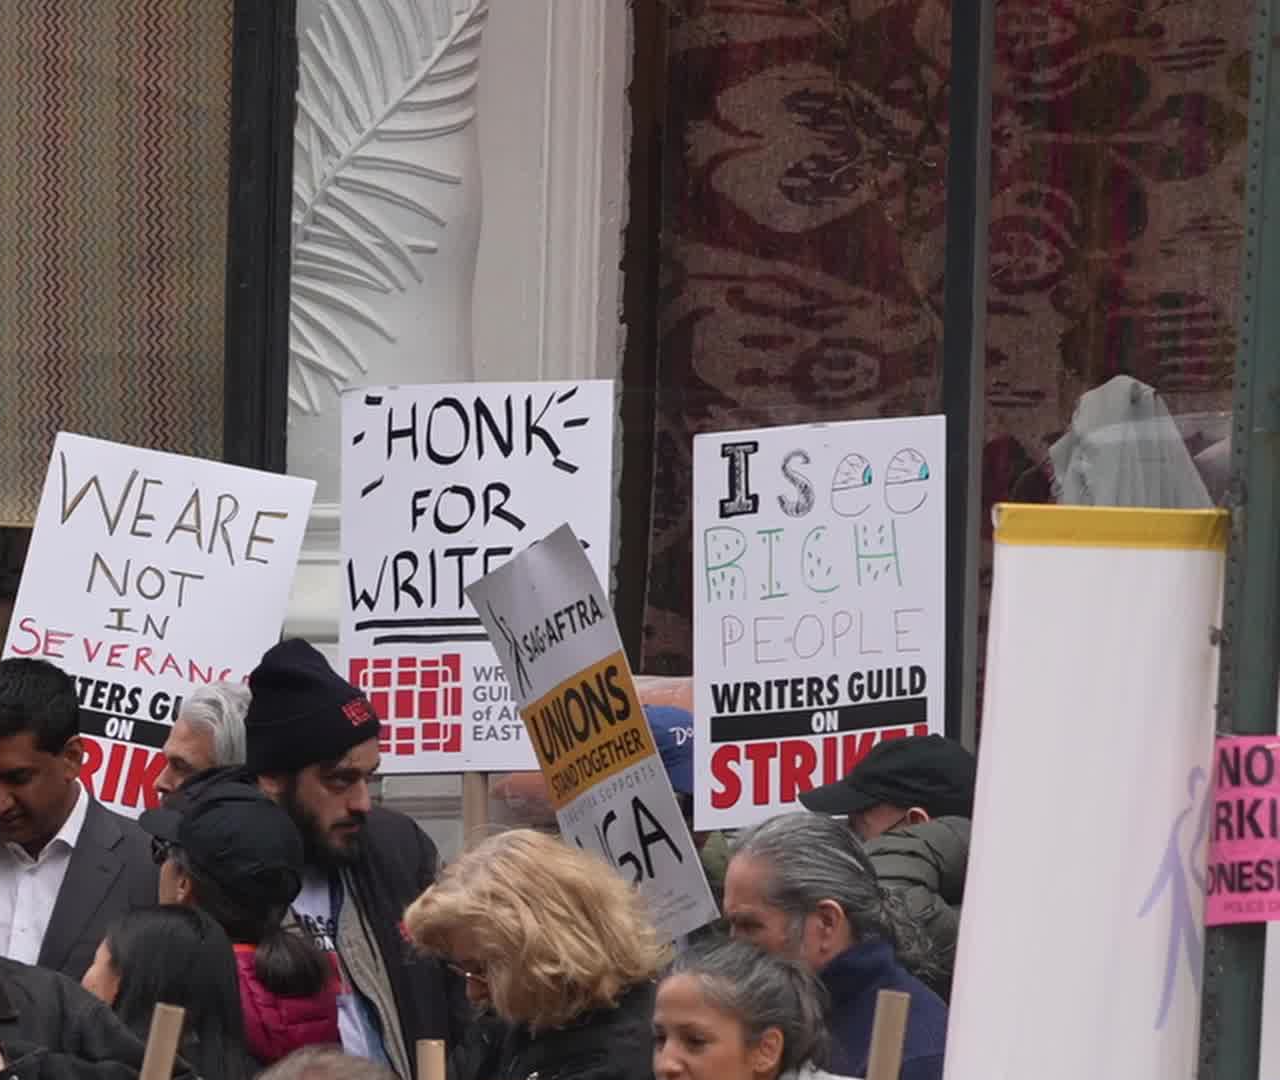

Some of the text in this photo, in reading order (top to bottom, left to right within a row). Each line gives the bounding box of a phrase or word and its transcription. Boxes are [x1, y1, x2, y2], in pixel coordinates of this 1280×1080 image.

[386, 391, 562, 466] HONK
[719, 441, 759, 518] I
[59, 450, 289, 567] WE ARE
[411, 481, 526, 535] FOR
[86, 552, 205, 608] NOT
[704, 519, 904, 603] RICH
[104, 607, 170, 641] IN
[722, 608, 924, 668] PEOPLE
[473, 706, 493, 721] of
[530, 665, 631, 764] UNIONS
[711, 666, 927, 714] WRITERS GUILD
[105, 716, 133, 741] ON
[472, 725, 523, 741] EAST
[811, 710, 838, 733] ON
[551, 728, 645, 800] STAND TOGETHER
[1217, 744, 1275, 788] NO
